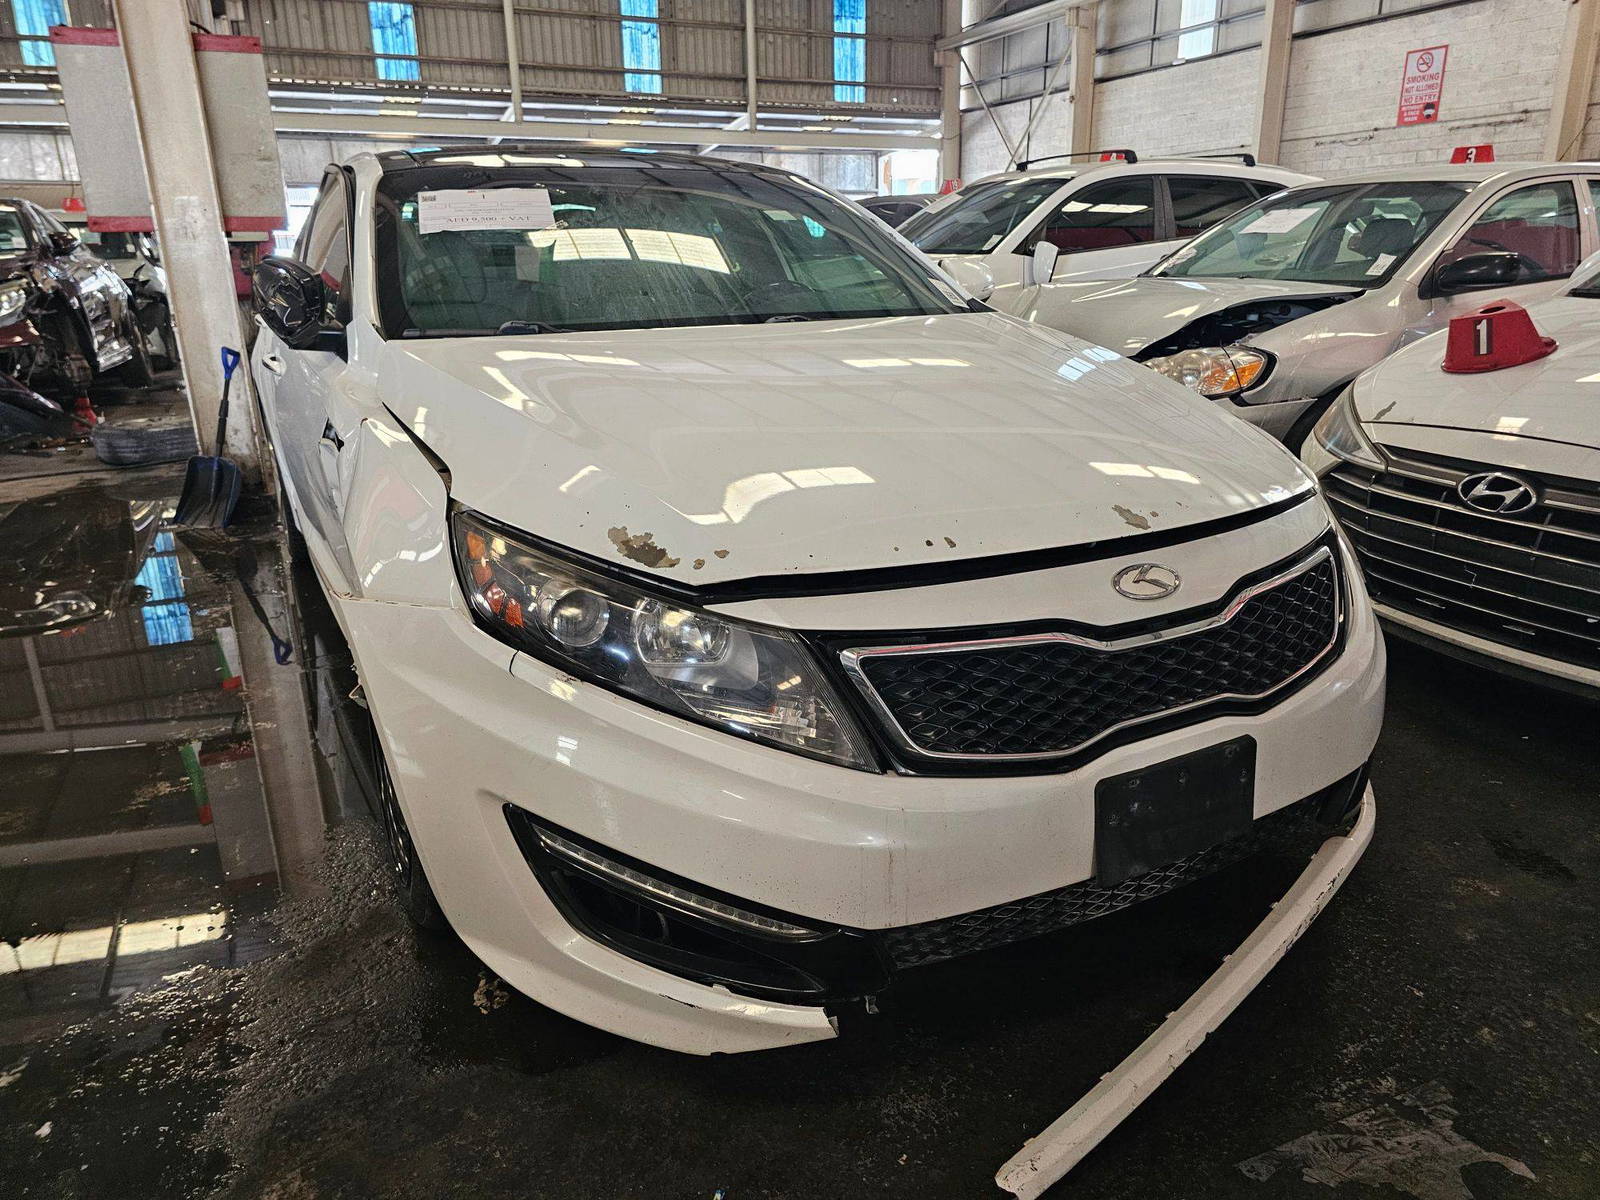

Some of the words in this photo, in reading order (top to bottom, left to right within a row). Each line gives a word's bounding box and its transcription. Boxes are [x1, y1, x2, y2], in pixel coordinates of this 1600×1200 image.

[1406, 72, 1440, 85] SMOKING
[1416, 82, 1439, 92] ALLOWED
[1403, 96, 1414, 105] NO
[1415, 94, 1437, 103] ENTRY
[1466, 148, 1476, 163] 3
[1476, 318, 1487, 355] 1
